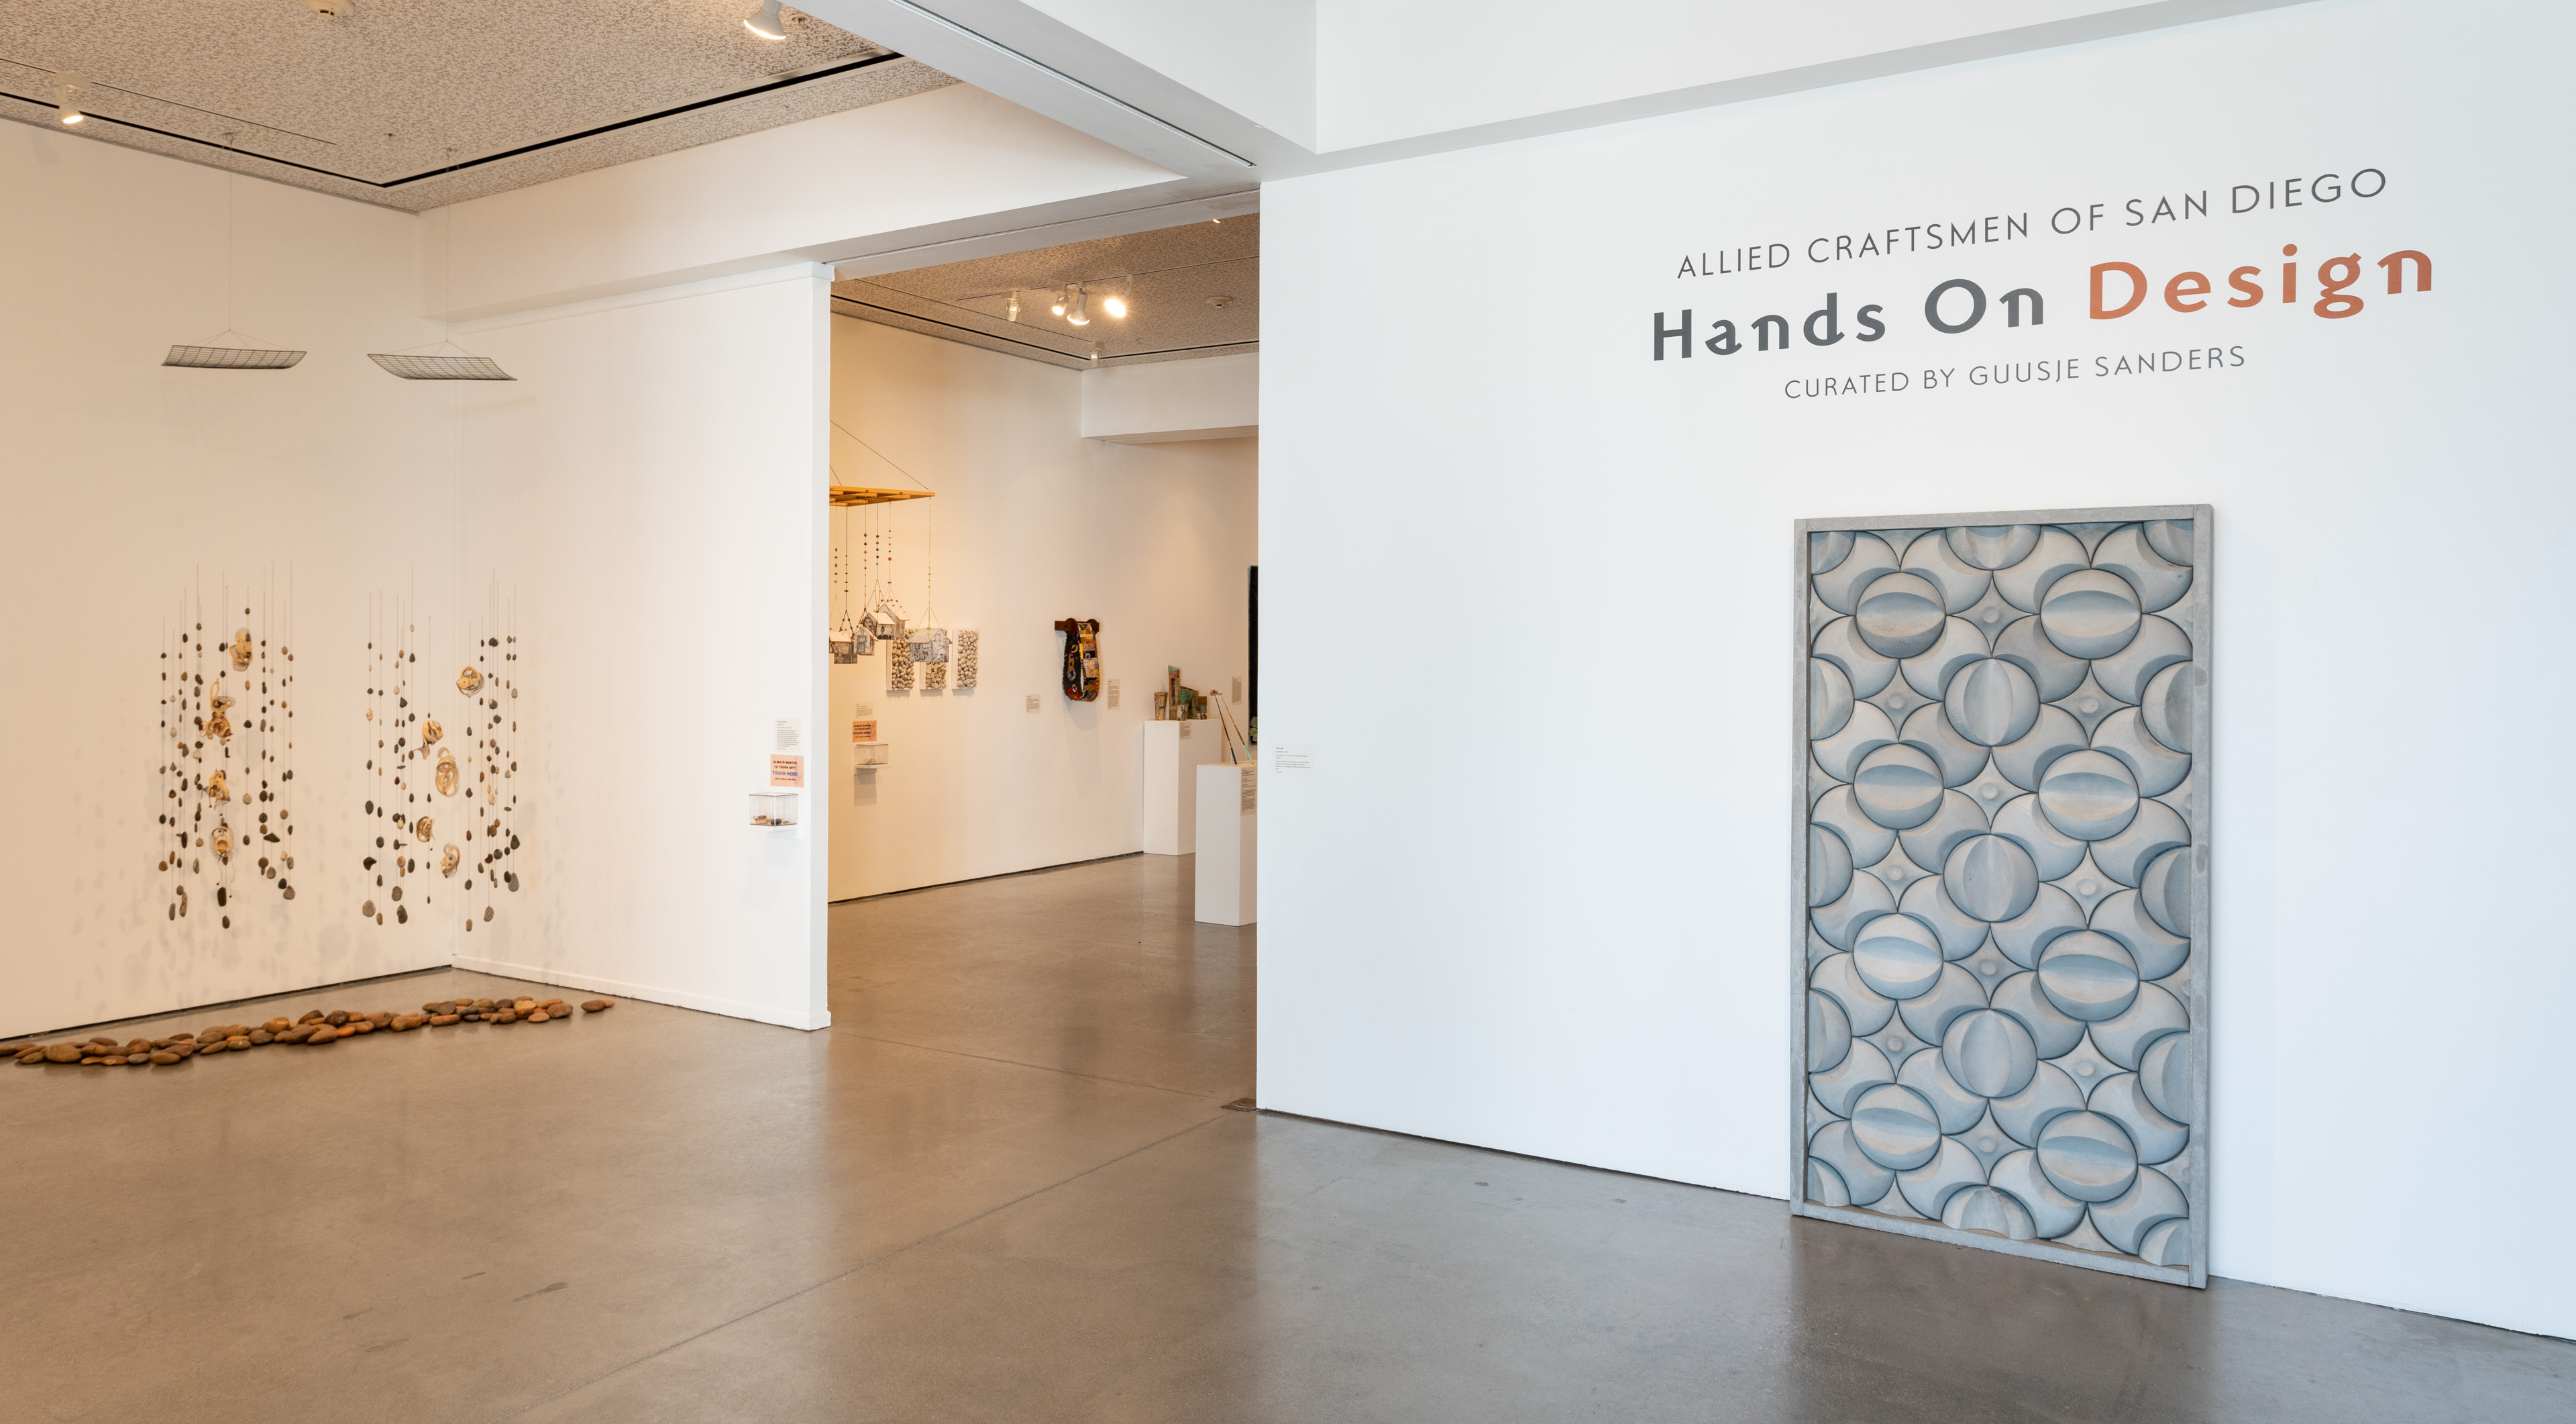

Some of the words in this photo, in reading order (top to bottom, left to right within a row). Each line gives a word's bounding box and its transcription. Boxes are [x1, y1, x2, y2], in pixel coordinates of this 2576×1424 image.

[1677, 243, 1790, 279] ALLIED
[1808, 212, 2027, 263] CRAFTSMEN
[2051, 203, 2104, 235] OF
[2125, 190, 2207, 227] SAN
[2232, 168, 2386, 214] DIEGO
[1654, 292, 1886, 362] Hands
[1924, 278, 2044, 334] On
[2089, 243, 2432, 320] Design
[1784, 372, 1909, 399] CURATED
[1924, 368, 1955, 389] BY
[1969, 358, 2079, 386] GUUSJE
[2095, 346, 2245, 377] SANDERS
